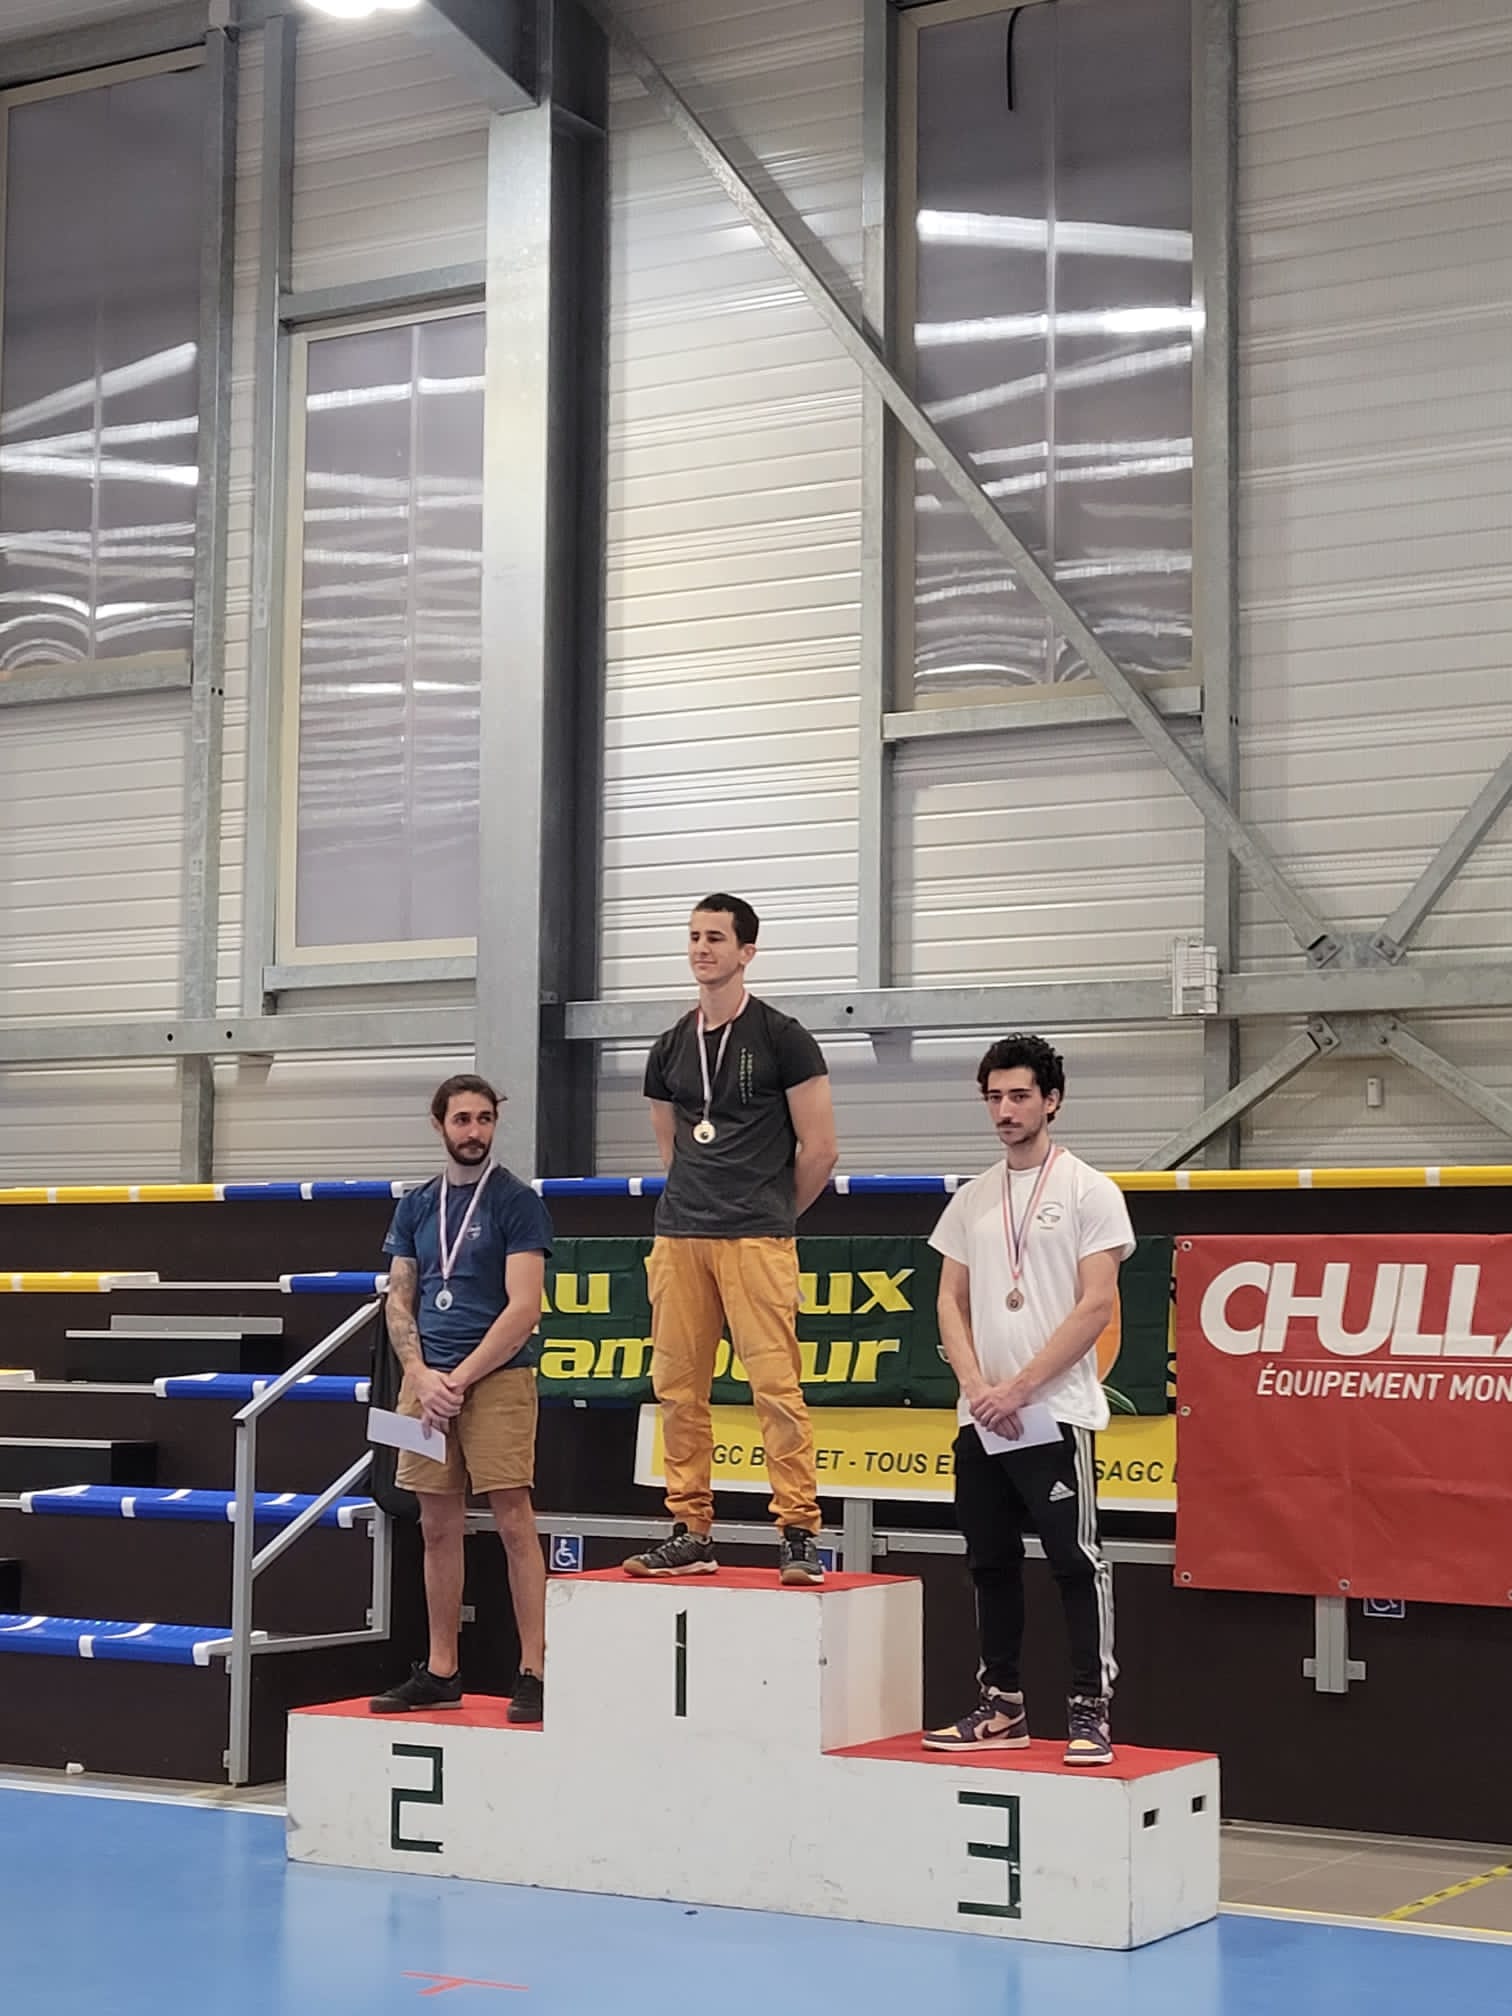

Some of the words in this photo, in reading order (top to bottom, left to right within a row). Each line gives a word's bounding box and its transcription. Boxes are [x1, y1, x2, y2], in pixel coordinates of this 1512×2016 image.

[1200, 1261, 1512, 1357] CHULL
[1257, 1362, 1444, 1401] ÉQUIPEMENT
[864, 1452, 928, 1474] TOUS
[675, 1610, 687, 1717] 1
[390, 1743, 444, 1854] 2
[957, 1790, 1022, 1920] 3
